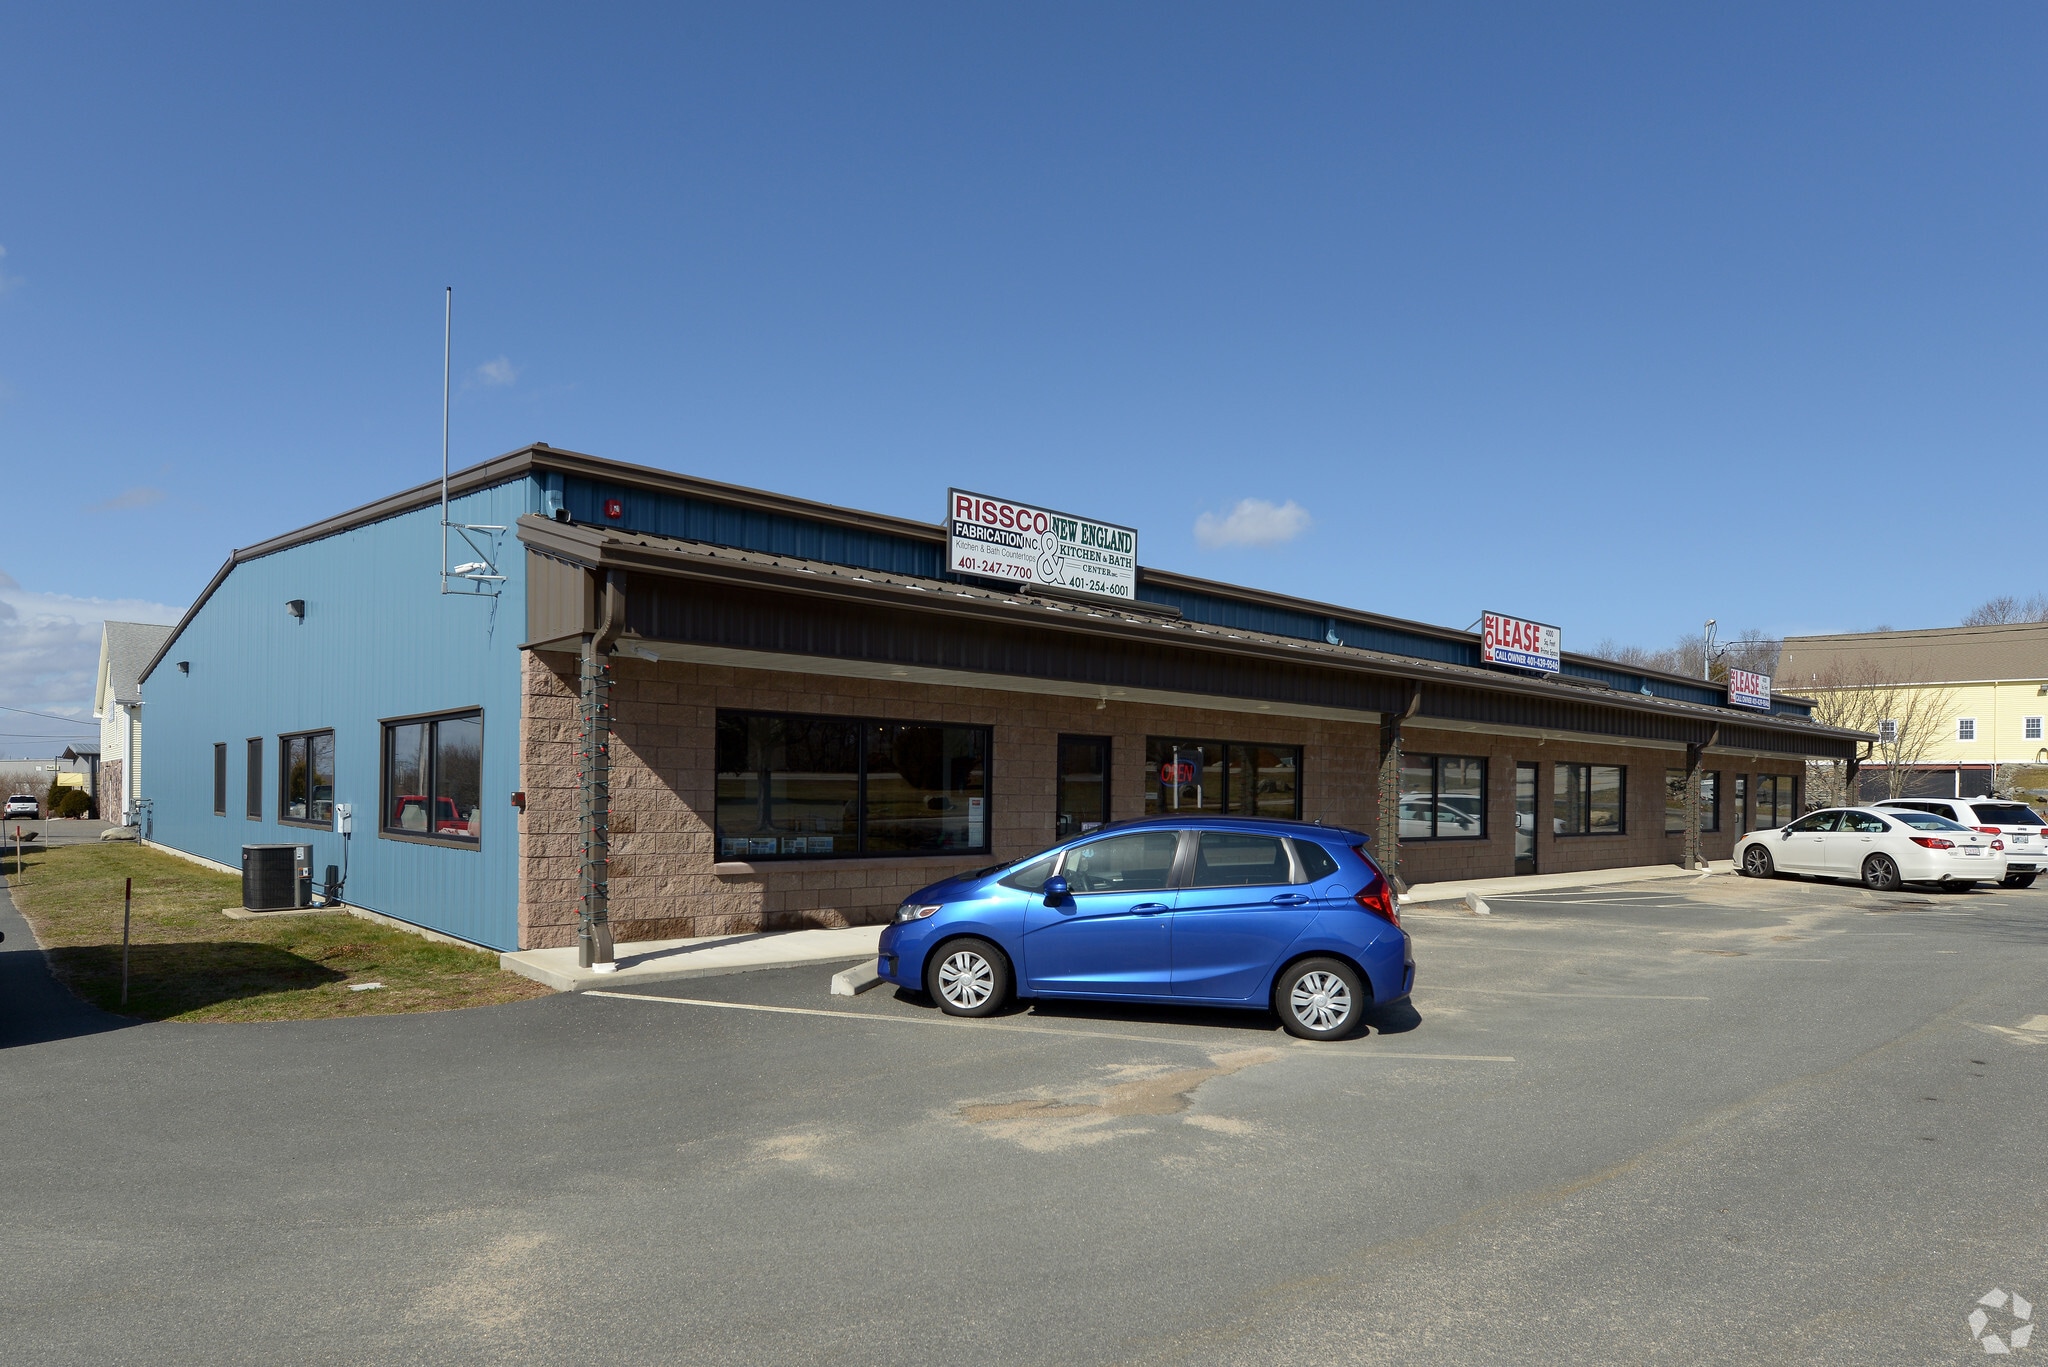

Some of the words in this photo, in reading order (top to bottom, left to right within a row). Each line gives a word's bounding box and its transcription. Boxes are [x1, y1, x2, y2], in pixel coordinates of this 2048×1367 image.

[956, 495, 1048, 535] RISSCO
[956, 523, 1022, 548] FABRICATION
[1022, 536, 1041, 551] INC.
[1052, 516, 1078, 542] NEW
[1081, 523, 1132, 554] ENGLAND
[956, 540, 979, 552] Kitchen
[980, 544, 985, 553] &
[986, 545, 1000, 555] Bath
[1001, 548, 1036, 563] Countertops
[1037, 530, 1066, 585] &
[1060, 544, 1101, 562] KITCHEN
[1102, 555, 1108, 563] &
[1108, 554, 1132, 568] BATH
[958, 556, 1032, 579] 401-247-7700
[1082, 564, 1111, 577] CENTER
[1069, 576, 1129, 596] 401-254-6001
[1485, 616, 1494, 661] FOR
[1495, 617, 1540, 653] LEASE
[1495, 650, 1507, 661] CALL
[1507, 652, 1527, 664] OWNER
[1540, 647, 1549, 656] Prime
[1549, 648, 1558, 657] Space
[1735, 671, 1759, 695] LEASE
[1161, 763, 1193, 782] OPEN
